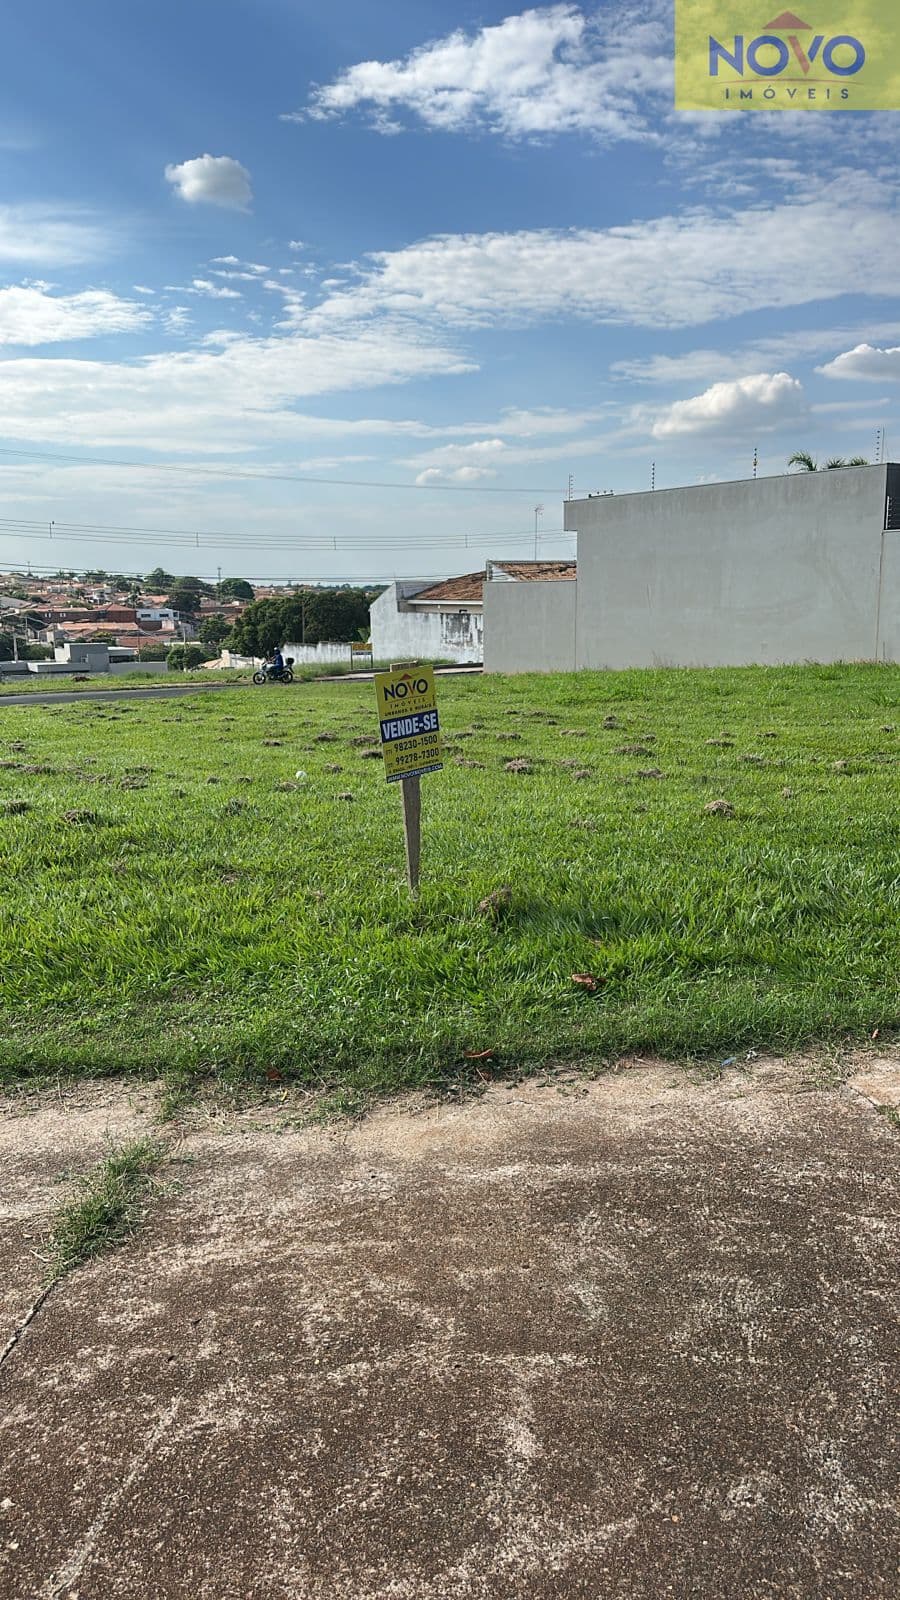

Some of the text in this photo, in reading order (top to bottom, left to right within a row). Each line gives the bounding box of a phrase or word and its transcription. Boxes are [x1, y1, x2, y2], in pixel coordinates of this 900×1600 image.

[383, 678, 428, 701] NOVO
[382, 712, 438, 739] VENDE-SE
[393, 734, 438, 752] 98230-1500
[395, 747, 440, 766] 99278-7300
